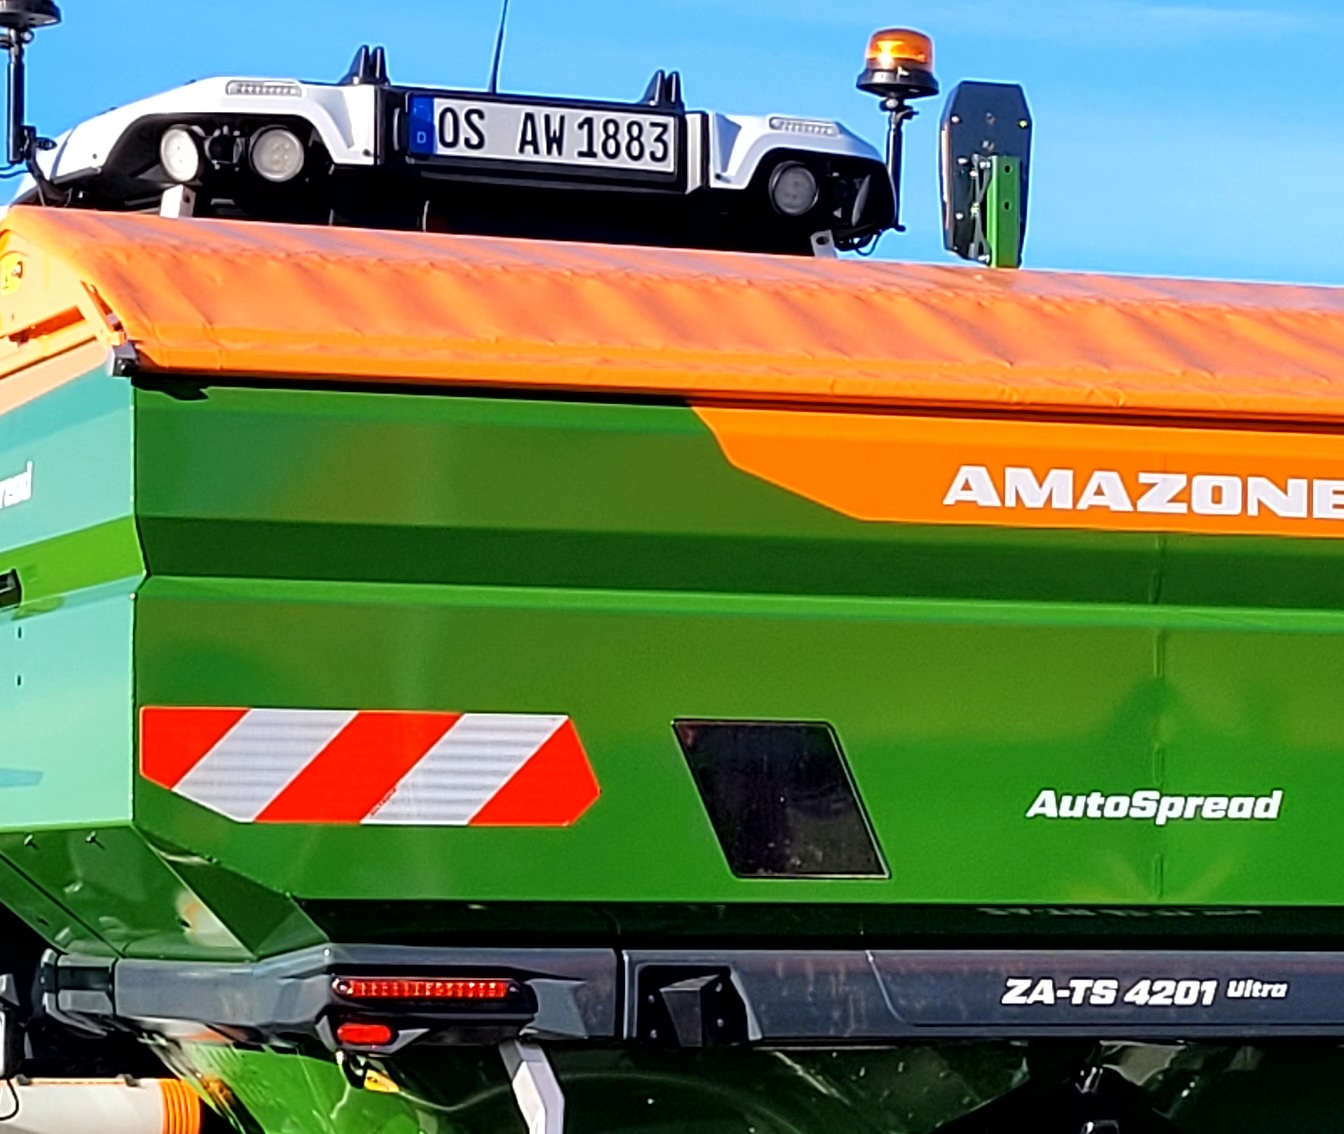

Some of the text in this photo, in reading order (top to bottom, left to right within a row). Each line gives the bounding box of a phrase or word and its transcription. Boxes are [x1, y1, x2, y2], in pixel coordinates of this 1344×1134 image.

[416, 107, 669, 162] D OS AW 1883
[1025, 789, 1283, 825] AutoSpread
[1001, 978, 1288, 1006] ZA-TS 4201 Ultra
